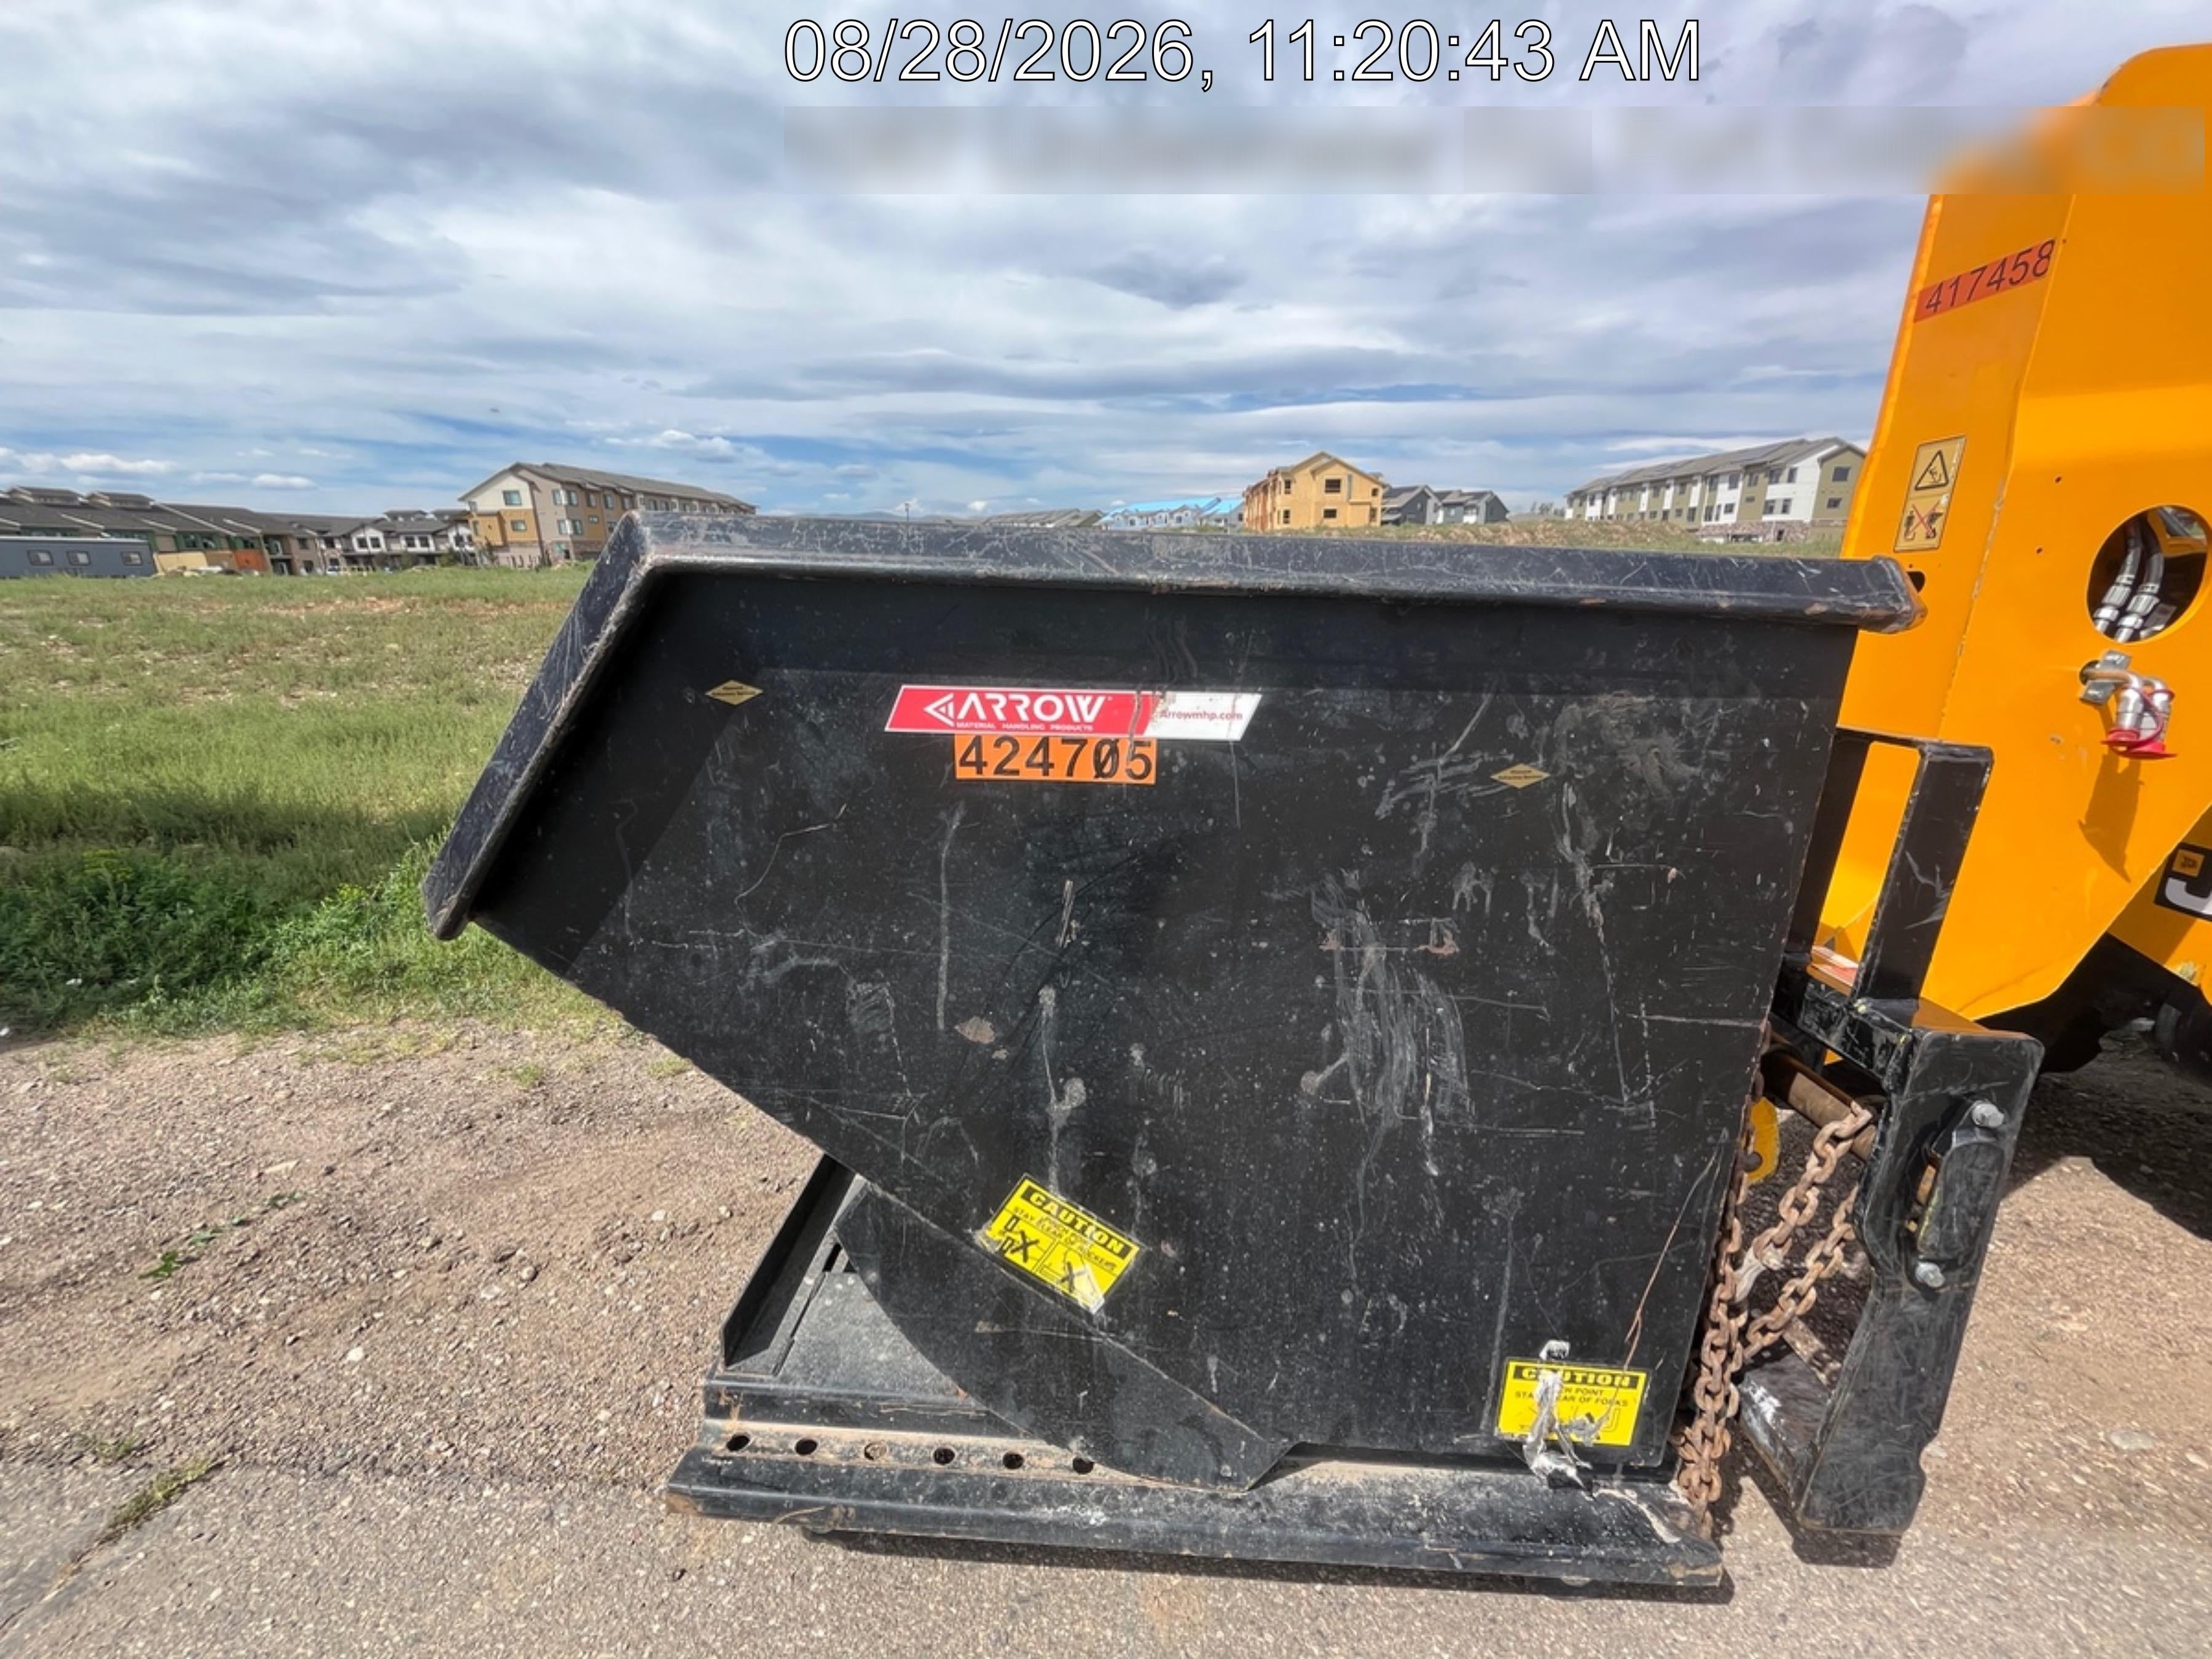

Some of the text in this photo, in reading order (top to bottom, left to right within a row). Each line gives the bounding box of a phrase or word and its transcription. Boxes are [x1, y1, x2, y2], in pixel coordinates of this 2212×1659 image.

[1925, 238, 2056, 313] 417458
[956, 692, 1106, 723] ARROW
[956, 721, 997, 730] MATERIAL
[1050, 724, 1093, 732] PRODUCTS
[959, 735, 1153, 780] 424705
[1029, 1191, 1126, 1255] CAUTION
[1521, 1368, 1631, 1387] CUTION
[1579, 1395, 1593, 1404] OF
